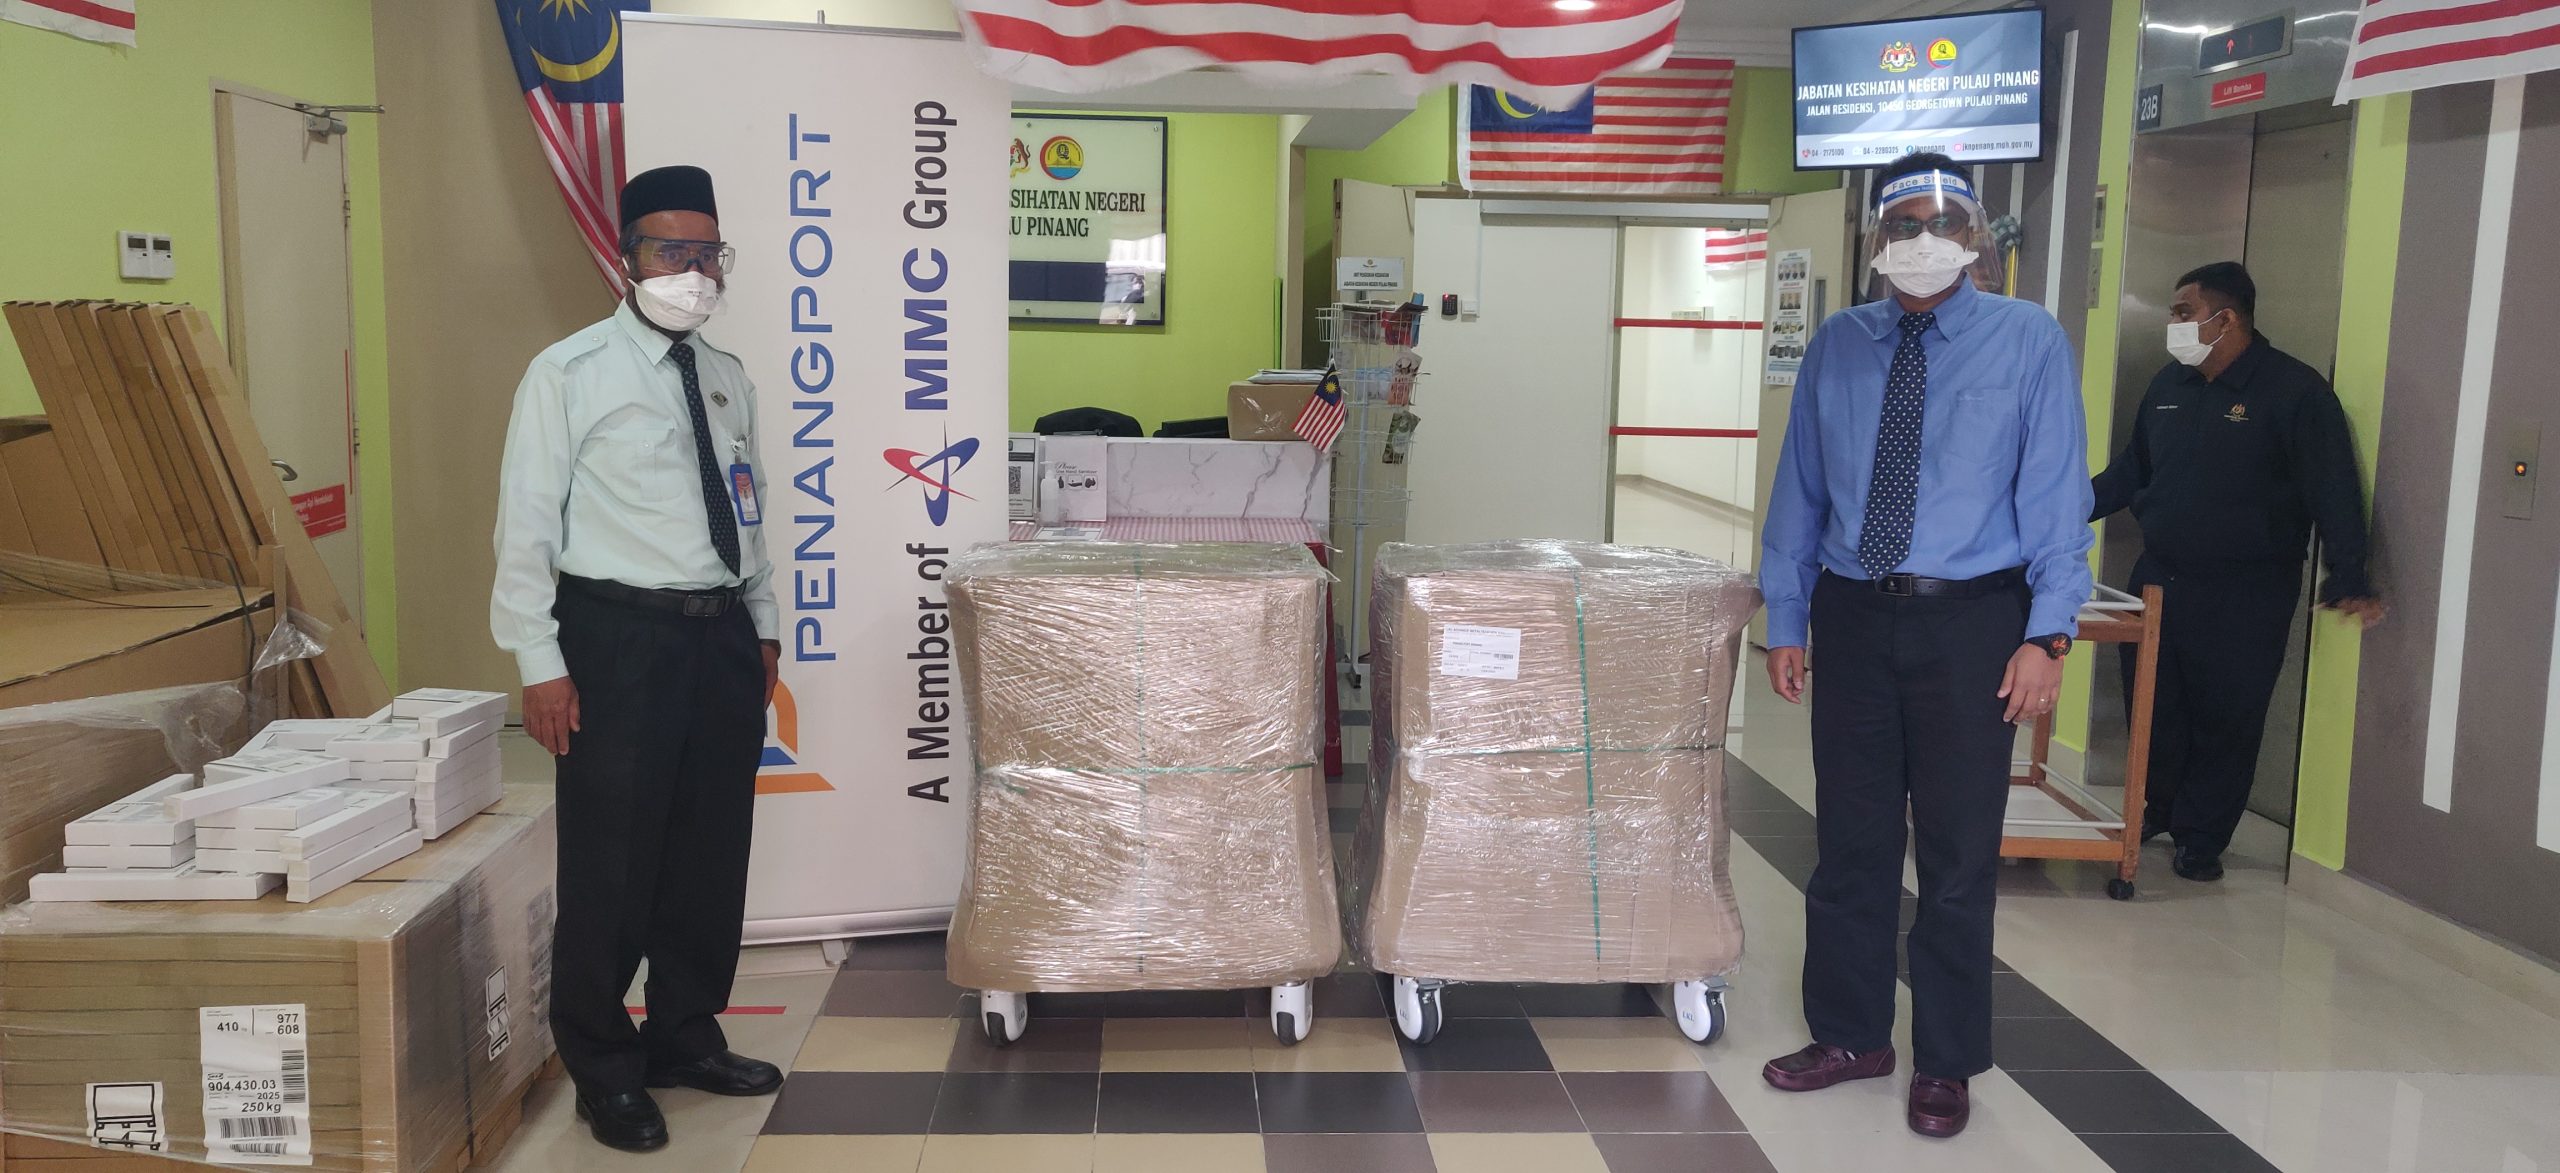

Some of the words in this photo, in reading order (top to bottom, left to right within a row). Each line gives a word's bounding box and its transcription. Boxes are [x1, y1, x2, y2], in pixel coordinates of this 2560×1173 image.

[1797, 84, 1842, 100] JABATAN
[1846, 80, 1904, 97] KESIHATAN
[1908, 76, 1949, 93] NEGERI
[1953, 74, 1990, 90] PULAU
[1994, 70, 2039, 87] PINANG
[1806, 105, 1830, 116] JALAN
[1832, 102, 1876, 115] RESIDENSI,
[1906, 96, 1962, 111] GEORGETOWN
[1965, 95, 1992, 107] PULAU
[1995, 93, 2028, 105] PINANG
[2140, 95, 2158, 121] 23B
[902, 101, 957, 229] Group
[1892, 178, 1918, 191] Face
[1009, 189, 1080, 210] SIHATAN
[1085, 191, 1146, 212] NEGERI
[1027, 217, 1089, 237] PINANG
[902, 247, 949, 411] MMC
[789, 113, 836, 661] PENANGPORT
[905, 542, 950, 581] of
[906, 596, 950, 760] Member
[907, 775, 950, 804] A
[217, 1021, 239, 1032] 410
[277, 1013, 299, 1024] 977
[277, 1024, 300, 1035] 608
[208, 1079, 276, 1091] 904.430.03
[257, 1091, 280, 1100] 2025
[241, 1101, 264, 1112] 250
[266, 1101, 281, 1113] kg
